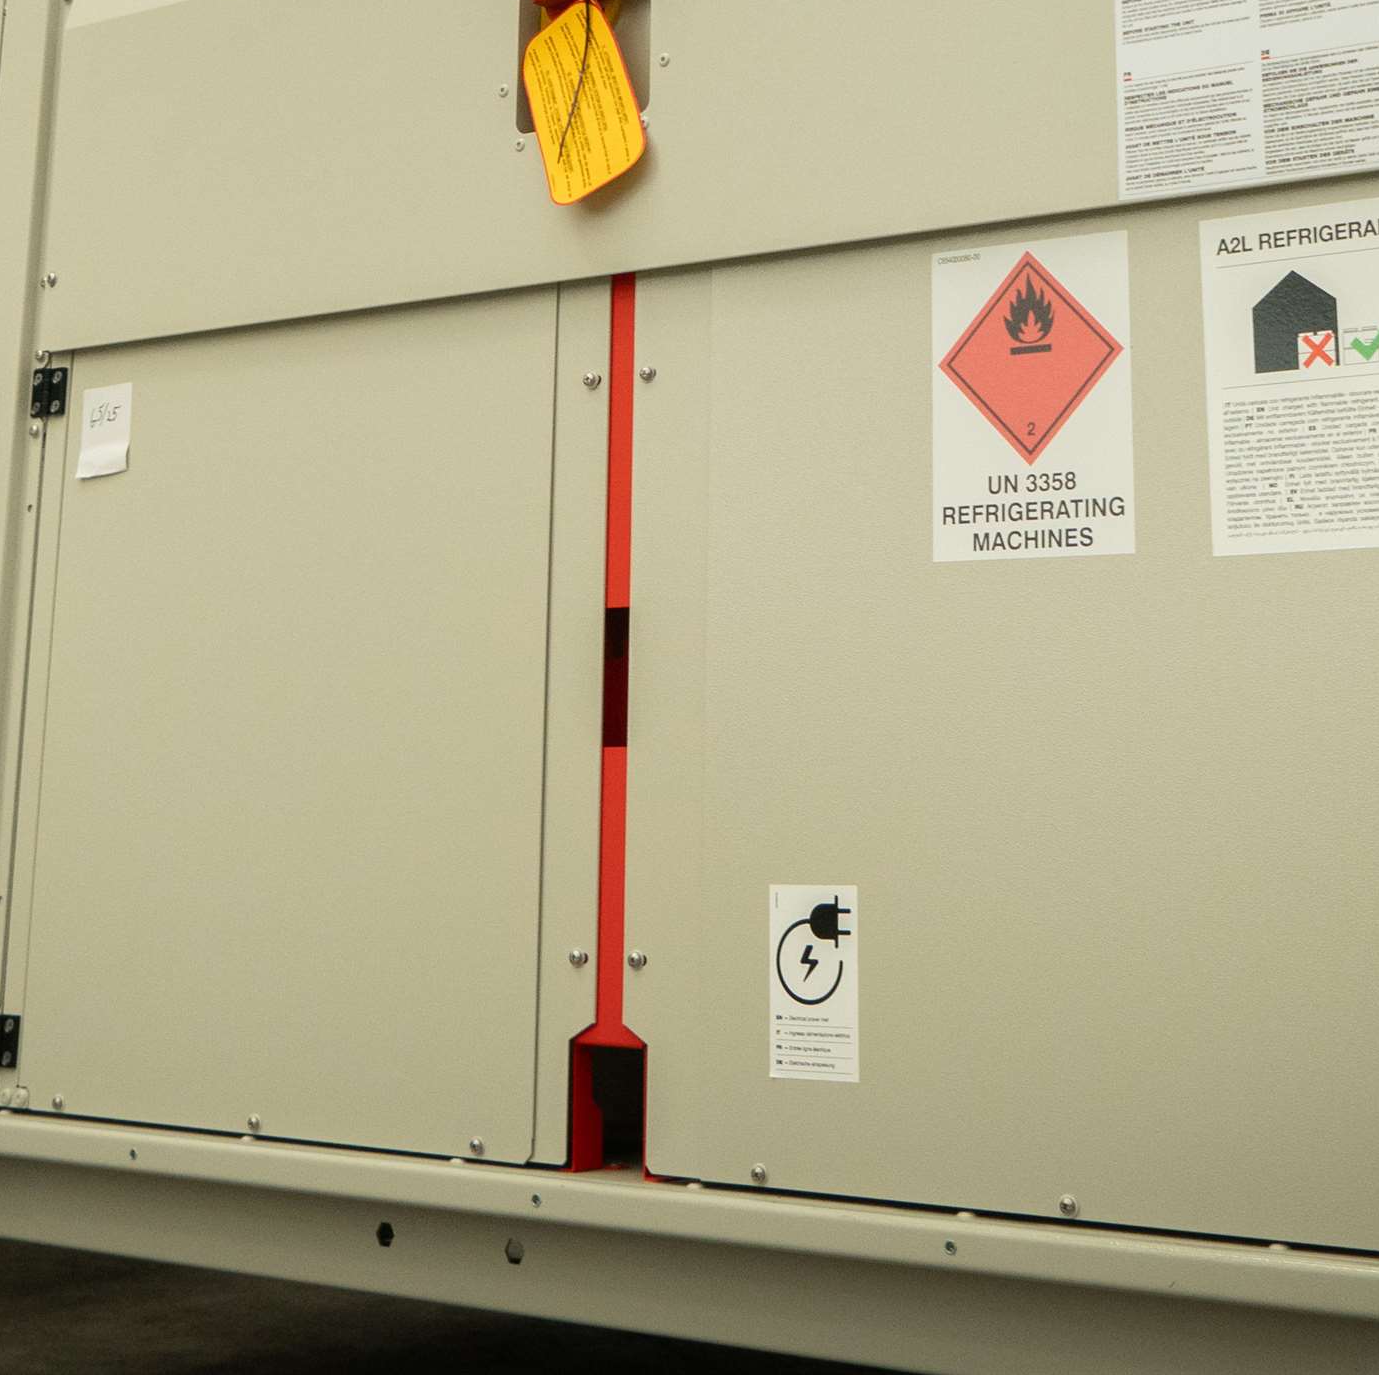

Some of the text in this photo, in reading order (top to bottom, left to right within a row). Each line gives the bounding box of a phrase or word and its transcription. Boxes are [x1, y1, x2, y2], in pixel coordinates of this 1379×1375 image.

[1217, 237, 1253, 255] A2L
[1026, 421, 1037, 436] 2
[988, 471, 1077, 495] UN 3358
[943, 496, 1125, 525] REFRIGERATING
[973, 527, 1094, 552] MACHINES
